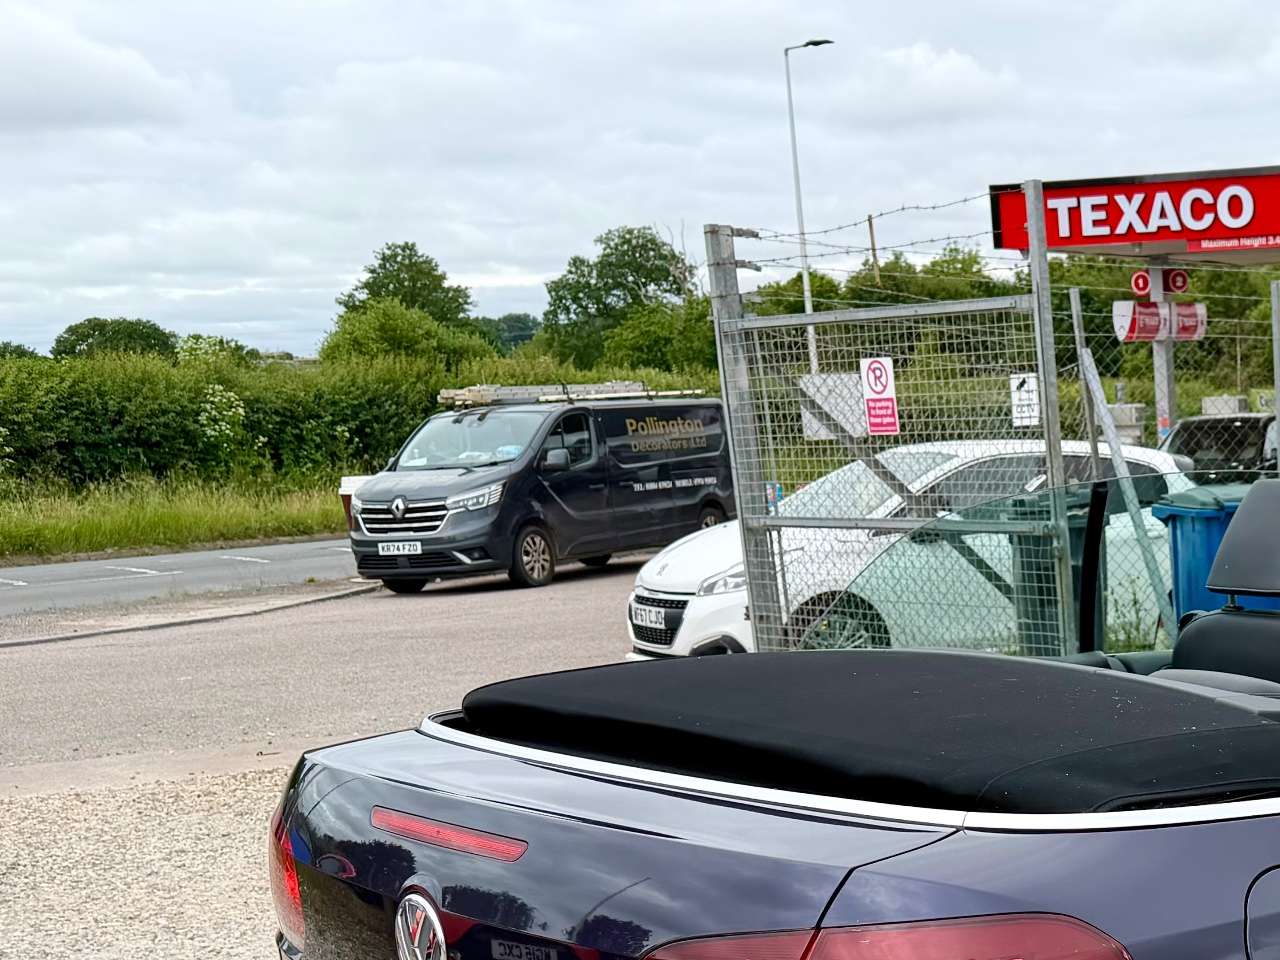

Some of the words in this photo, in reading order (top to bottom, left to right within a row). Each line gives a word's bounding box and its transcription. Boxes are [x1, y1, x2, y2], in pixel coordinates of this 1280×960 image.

[1047, 185, 1254, 238] TEXACO
[1201, 239, 1239, 248] Maximum
[1240, 237, 1266, 247] Height
[625, 416, 704, 436] Pollington
[631, 437, 688, 452] Decorators
[691, 436, 706, 448] Ltd
